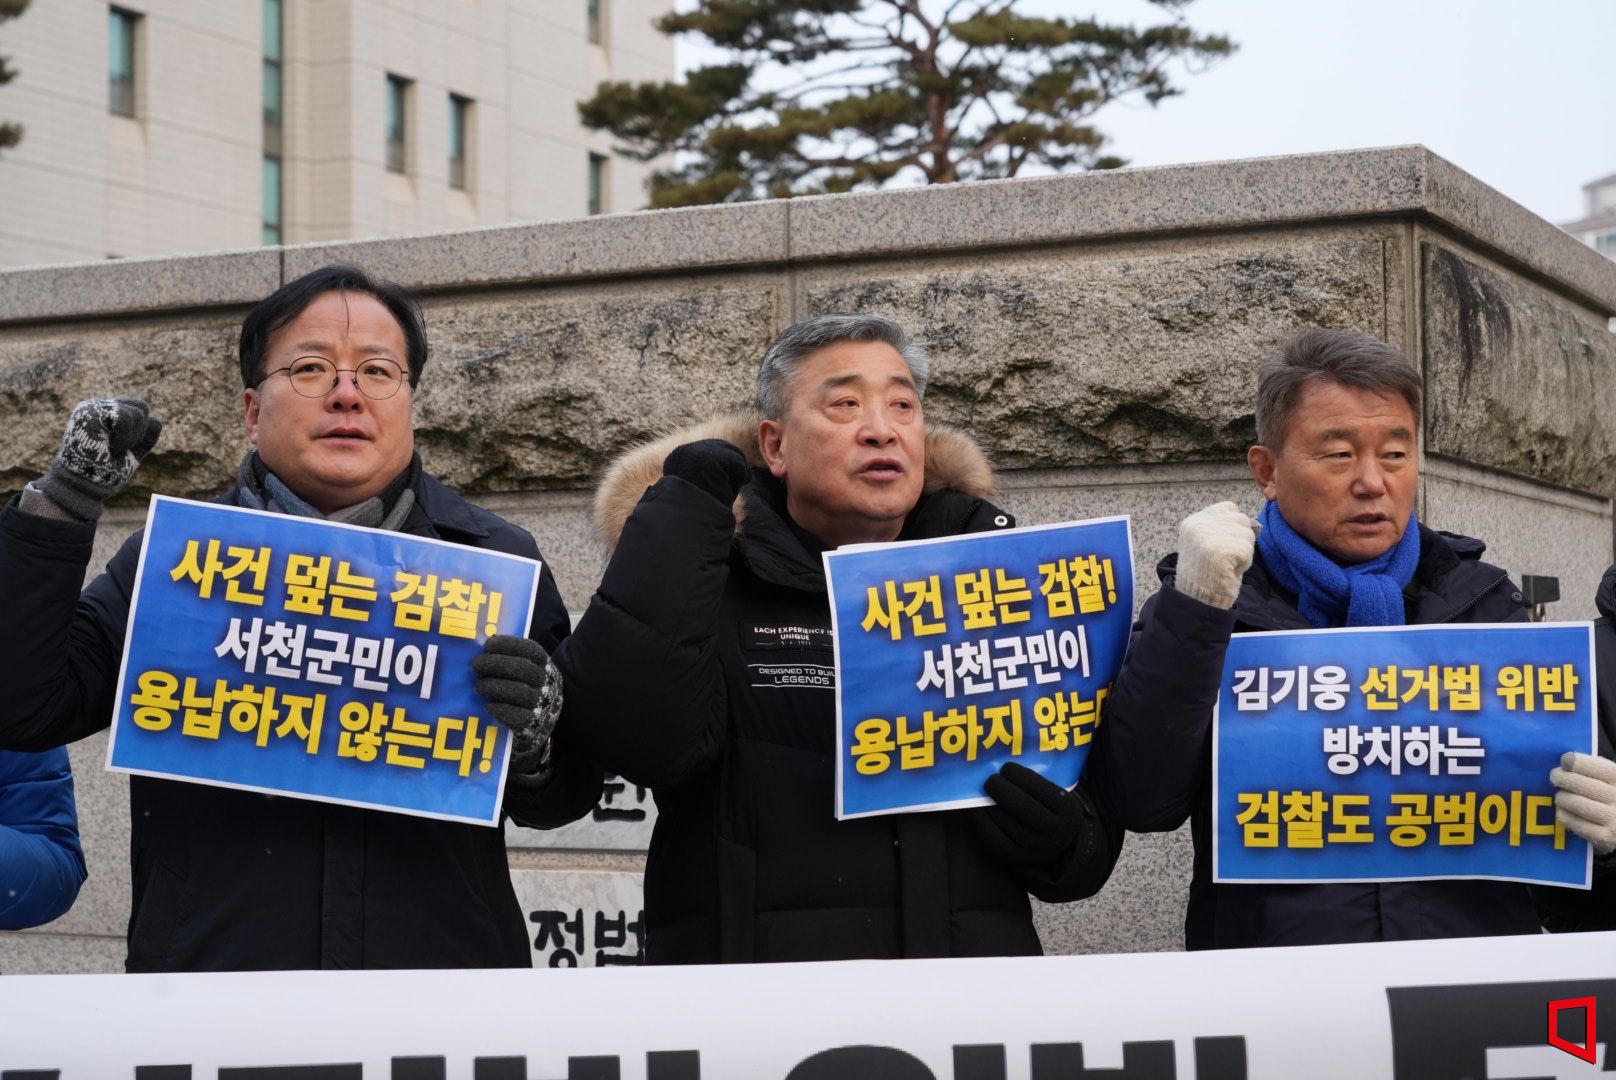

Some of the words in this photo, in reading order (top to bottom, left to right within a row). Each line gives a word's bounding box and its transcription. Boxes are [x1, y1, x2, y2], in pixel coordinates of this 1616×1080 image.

[170, 539, 272, 606] 사건
[283, 553, 377, 622] 덮는
[390, 570, 503, 640] 검찰!
[860, 575, 947, 641] 사건
[955, 568, 1032, 631] 덮는
[1038, 554, 1117, 618] 검찰!
[214, 616, 438, 699] 서천군민이
[778, 626, 825, 635] EXPERIENCE
[916, 624, 1091, 699] 서천군민이
[758, 667, 803, 675] DESIGNED
[774, 676, 830, 685] LEGENDS
[1231, 665, 1351, 711] 김기웅
[1359, 664, 1481, 711] 선거법
[1496, 664, 1579, 712] 위반
[130, 670, 327, 755] 용납하지
[337, 700, 499, 778] 않는다!
[850, 698, 1023, 776] 용납하지
[1323, 724, 1485, 776] 방치하는
[1235, 790, 1375, 849] 검찰도
